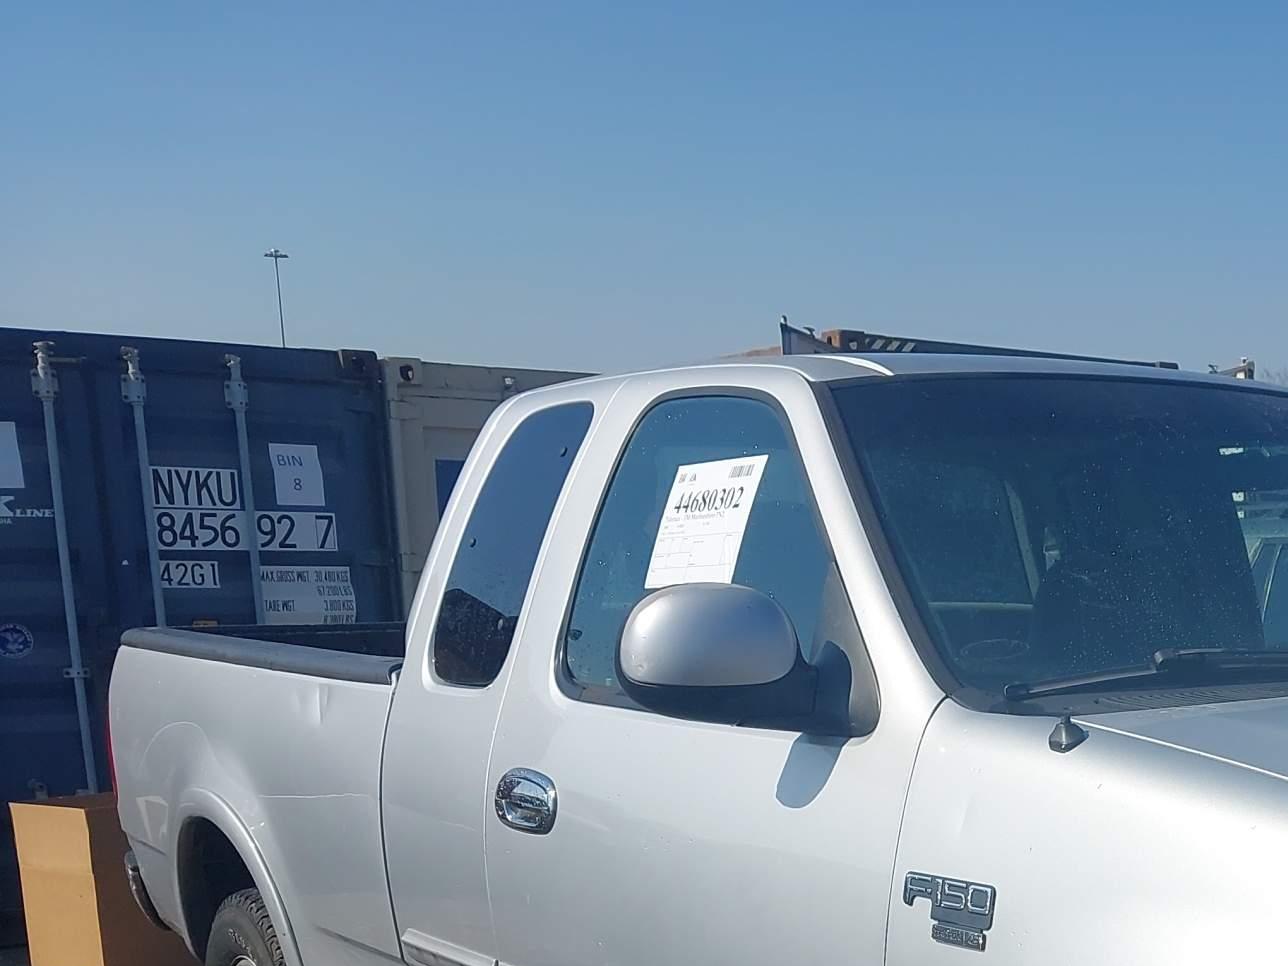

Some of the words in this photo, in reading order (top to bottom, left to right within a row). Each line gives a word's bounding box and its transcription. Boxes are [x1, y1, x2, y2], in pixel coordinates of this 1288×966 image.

[276, 454, 303, 467] BIN
[152, 468, 238, 507] NYKU
[293, 478, 303, 491] 8
[674, 486, 744, 514] 44680302
[15, 508, 55, 518] LINE
[315, 515, 334, 549] 7
[161, 563, 219, 586] 42G1
